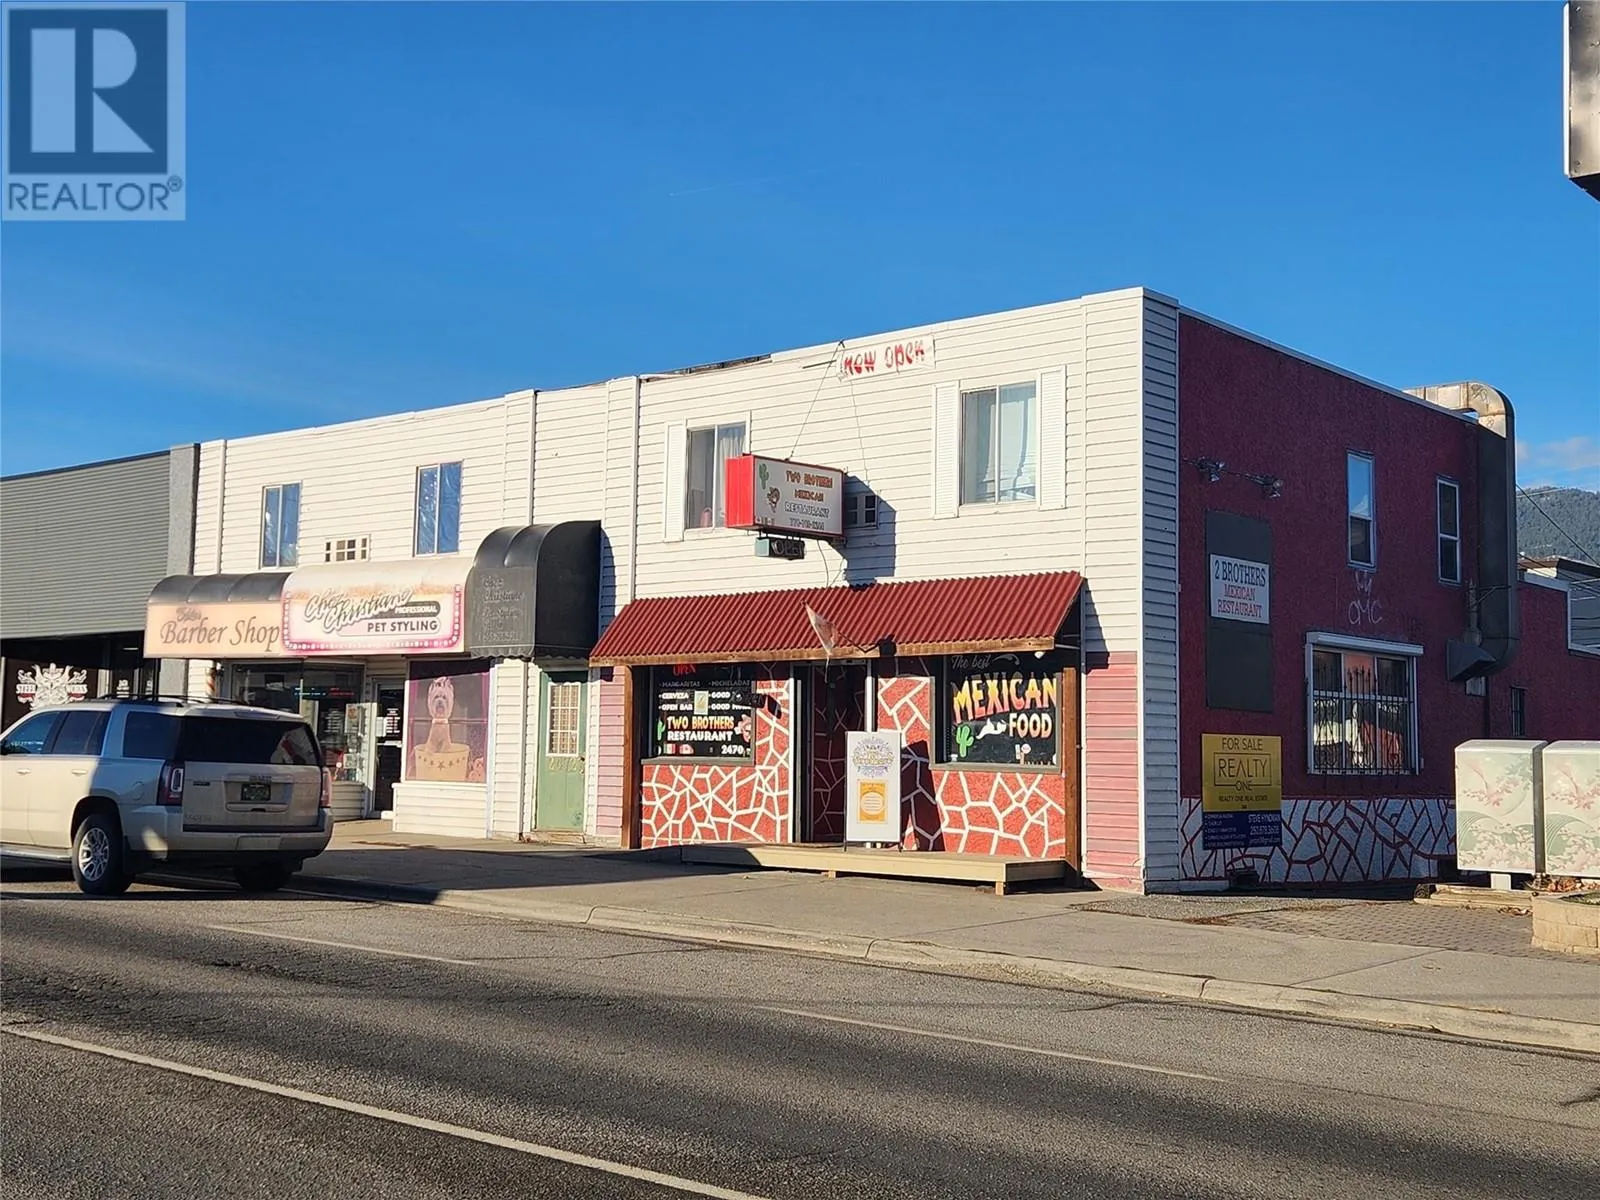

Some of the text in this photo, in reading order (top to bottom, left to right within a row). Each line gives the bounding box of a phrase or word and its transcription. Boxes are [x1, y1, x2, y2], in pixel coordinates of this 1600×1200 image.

[785, 470, 833, 489] TWO BROTHERS
[794, 489, 824, 502] MEXICAN
[785, 501, 830, 518] RESTAURANT
[1214, 560, 1266, 587] 2 BROTHERS
[1224, 583, 1256, 601] MEXICAN
[1217, 599, 1263, 618] RESTAURANT
[160, 615, 280, 653] Barber Shop
[367, 620, 438, 633] PET STYLING
[952, 654, 969, 669] The
[711, 691, 731, 699] GOOD
[950, 671, 1057, 724] MEXICAN
[667, 716, 735, 730] TWO BROTHERS
[1008, 712, 1053, 739] FOOD
[667, 730, 734, 742] RESTAURANT
[1221, 737, 1264, 751] FOR SALE
[721, 744, 745, 755] 2470
[1218, 758, 1268, 778] REALTY
[1235, 780, 1253, 792] ONE
